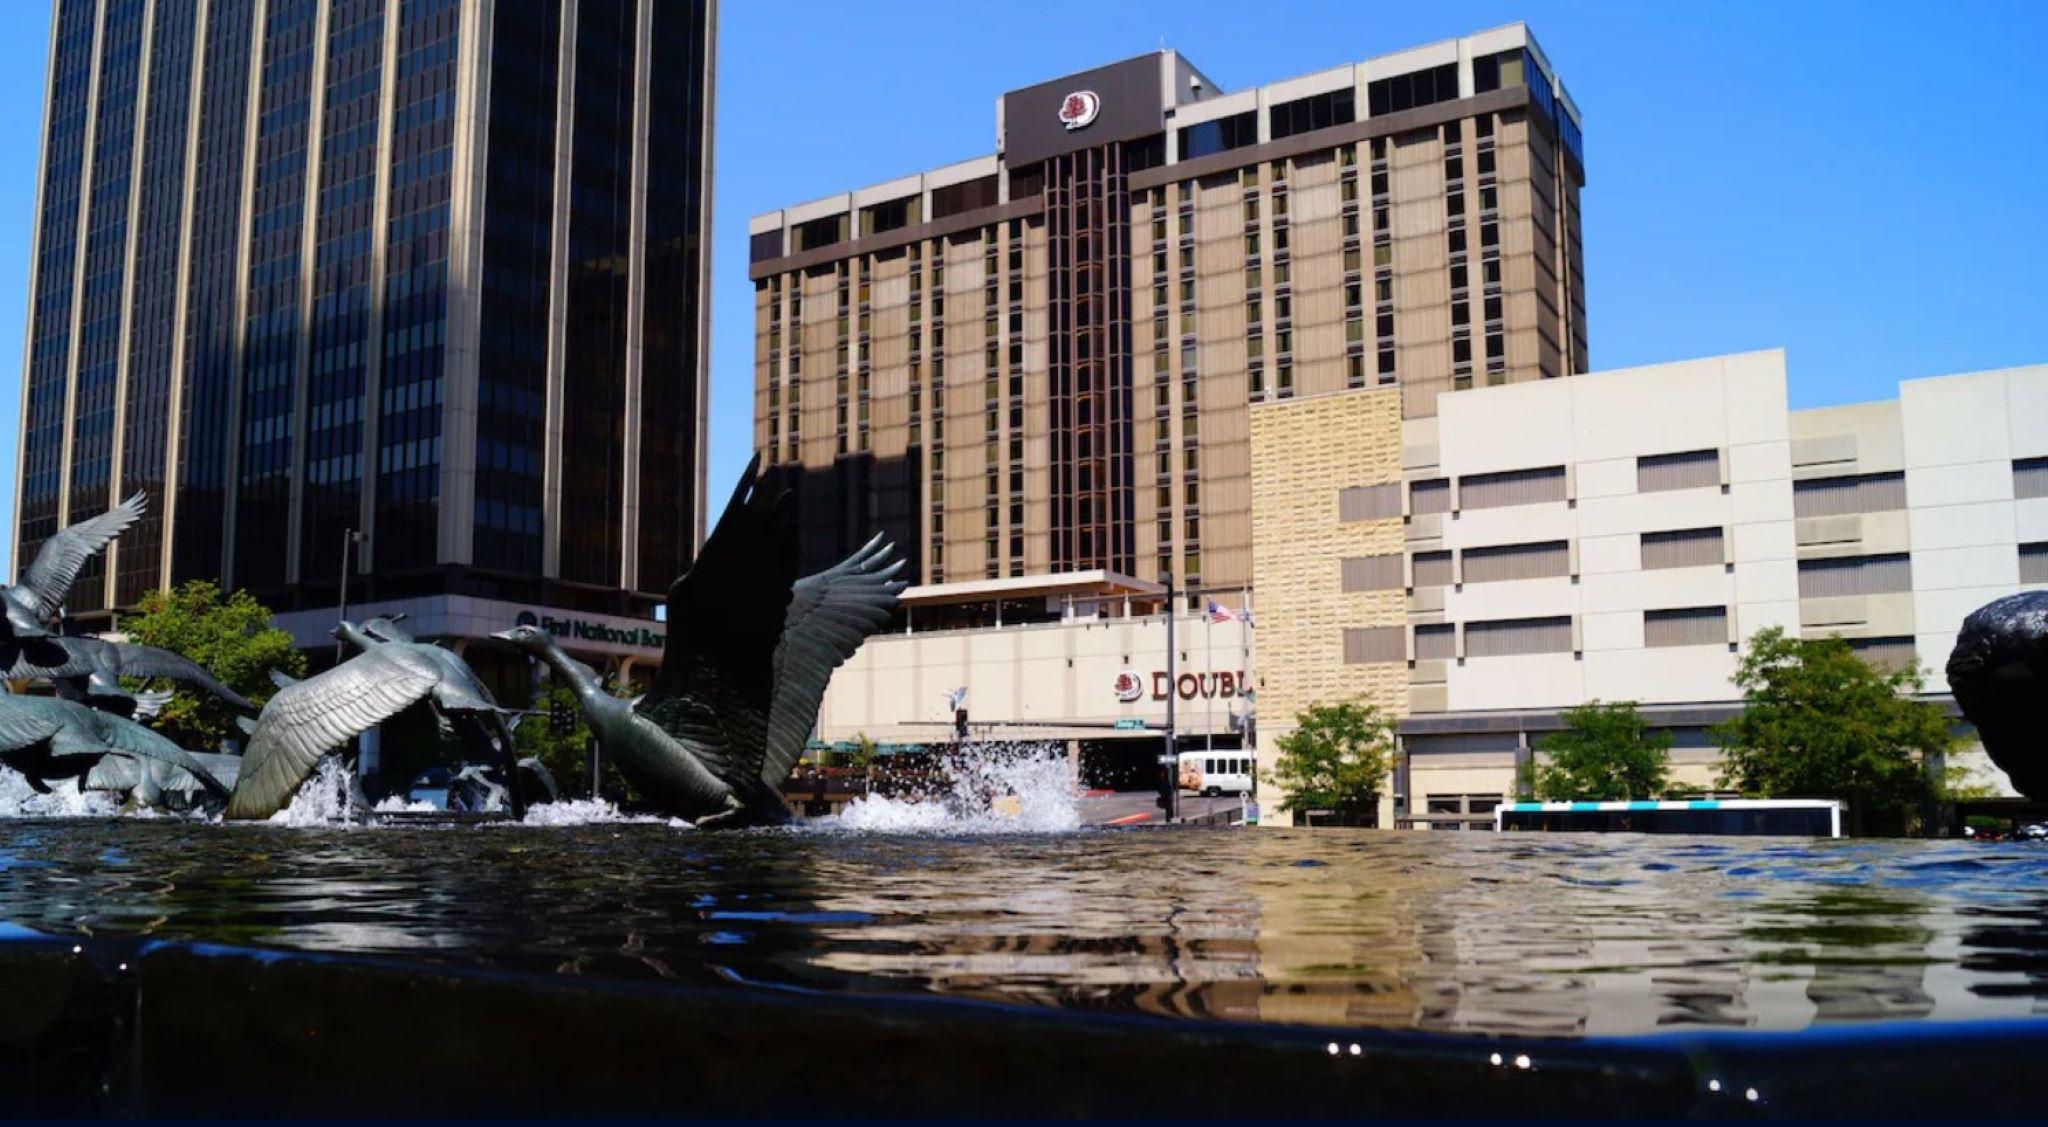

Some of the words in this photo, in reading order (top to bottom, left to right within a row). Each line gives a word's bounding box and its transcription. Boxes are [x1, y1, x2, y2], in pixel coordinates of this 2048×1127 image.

[574, 619, 639, 645] National
[641, 629, 667, 648] Ban
[1152, 671, 1254, 700] DOUBL
